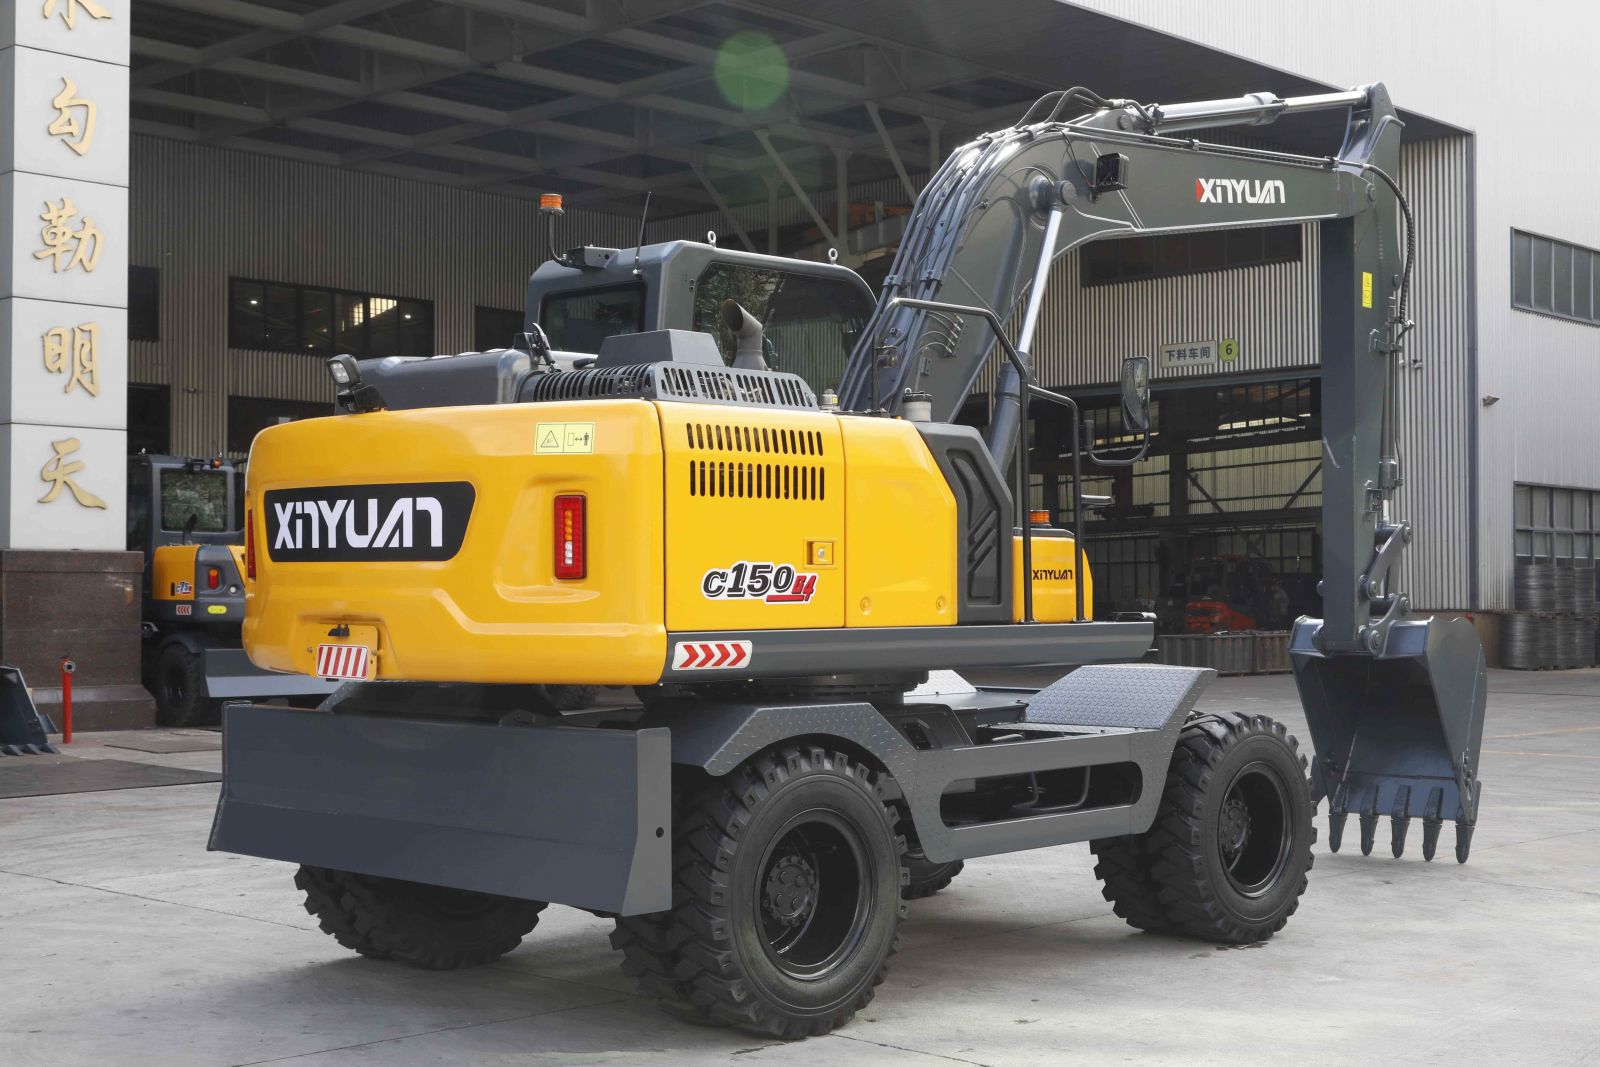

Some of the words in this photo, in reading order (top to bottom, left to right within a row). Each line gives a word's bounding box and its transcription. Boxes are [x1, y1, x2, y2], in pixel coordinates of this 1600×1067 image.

[1165, 346, 1211, 362] 下料车间
[1225, 344, 1233, 355] 6
